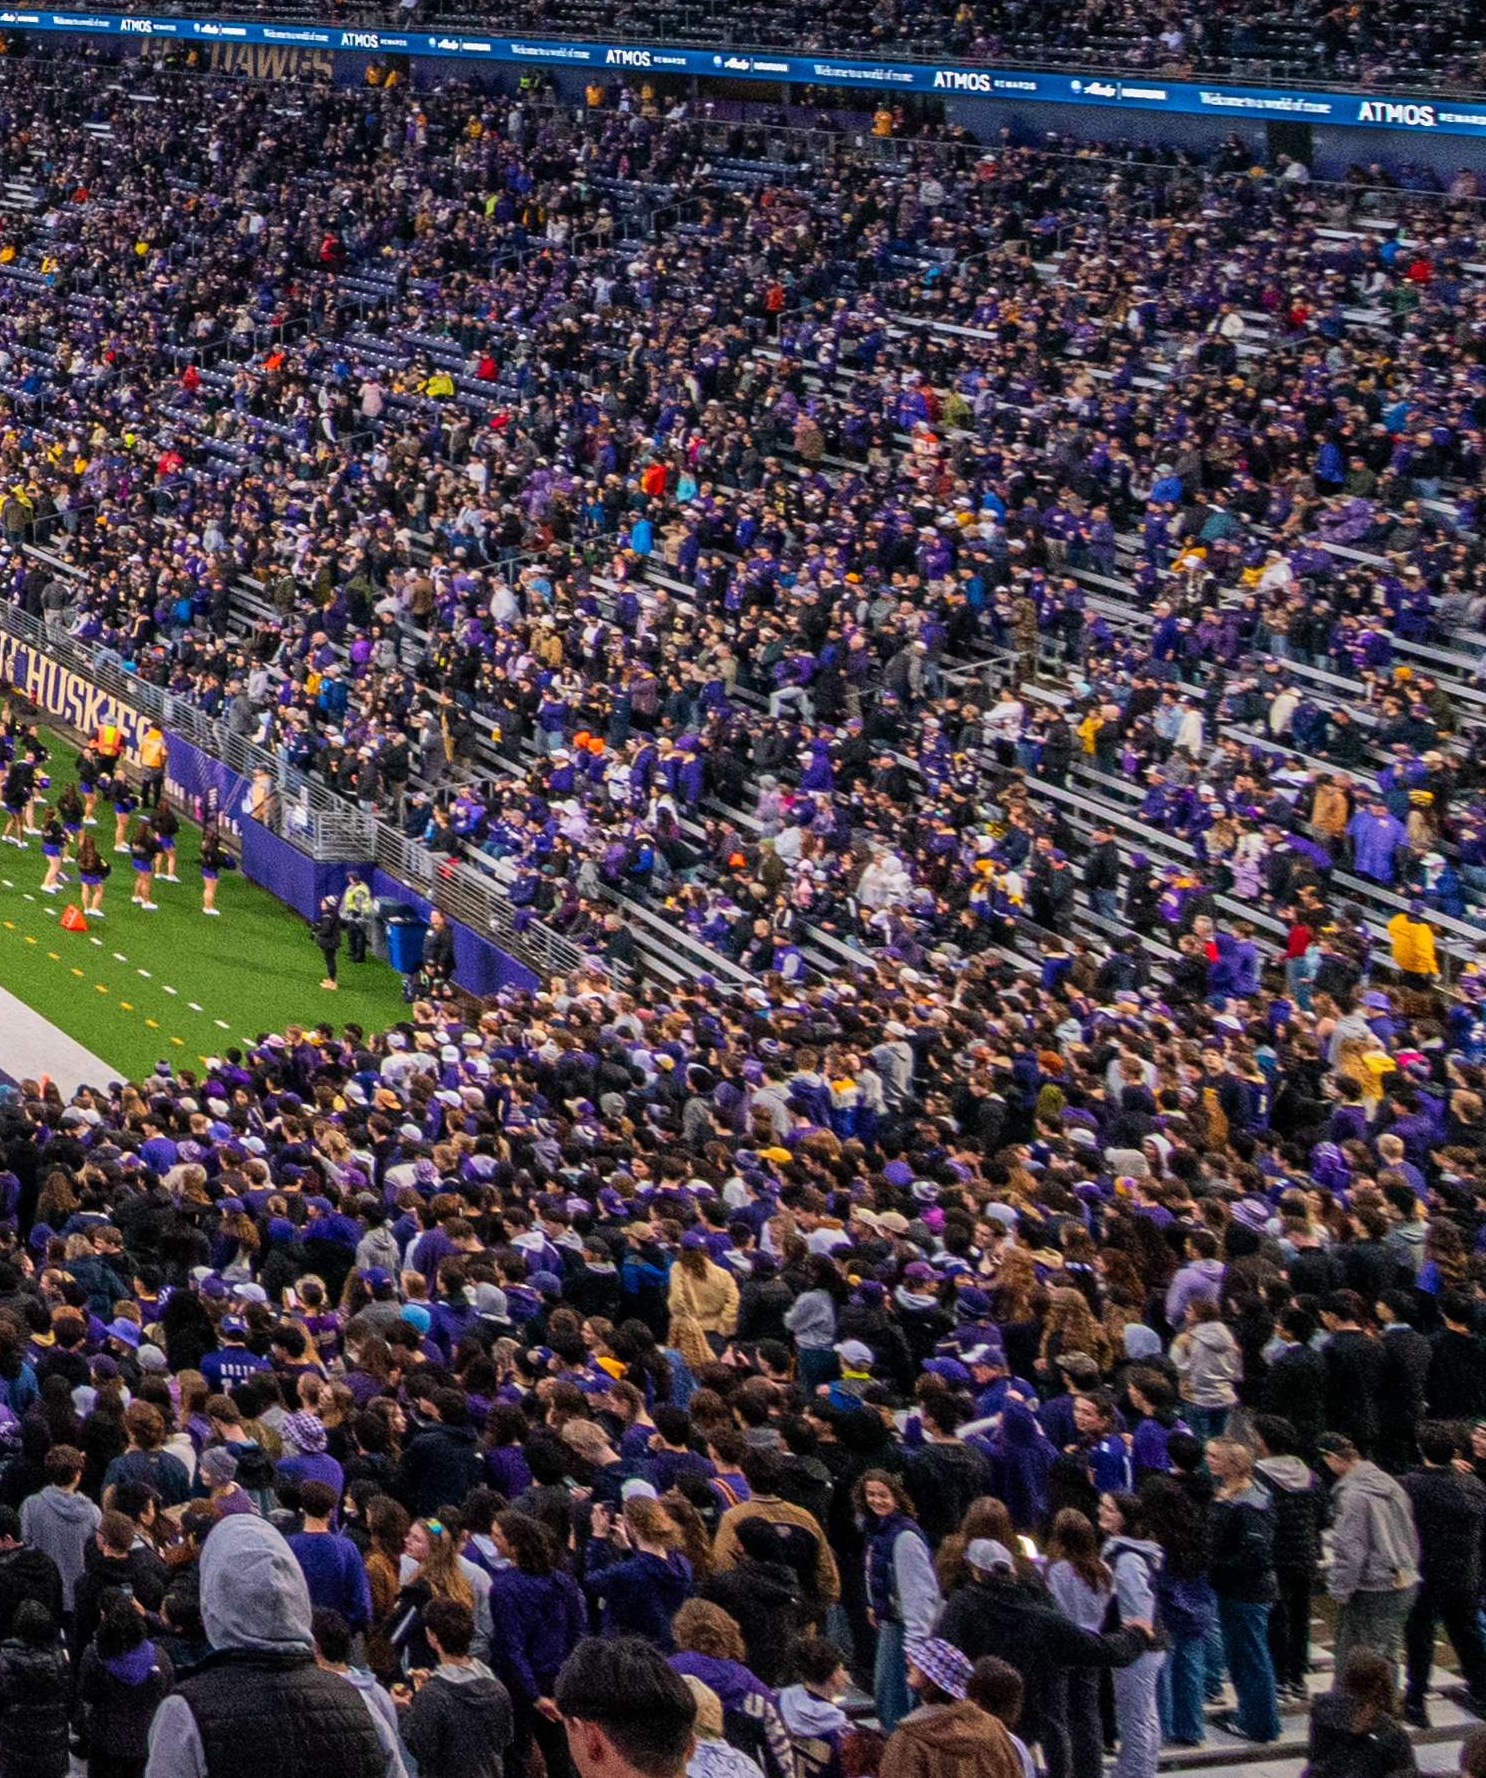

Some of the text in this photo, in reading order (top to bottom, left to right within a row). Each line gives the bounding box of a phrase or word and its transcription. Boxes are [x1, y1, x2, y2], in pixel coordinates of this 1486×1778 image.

[341, 32, 379, 48] ATMOS
[606, 49, 651, 66] ATMOS
[933, 70, 992, 92] ATMOS
[1358, 100, 1439, 127] ATMOS
